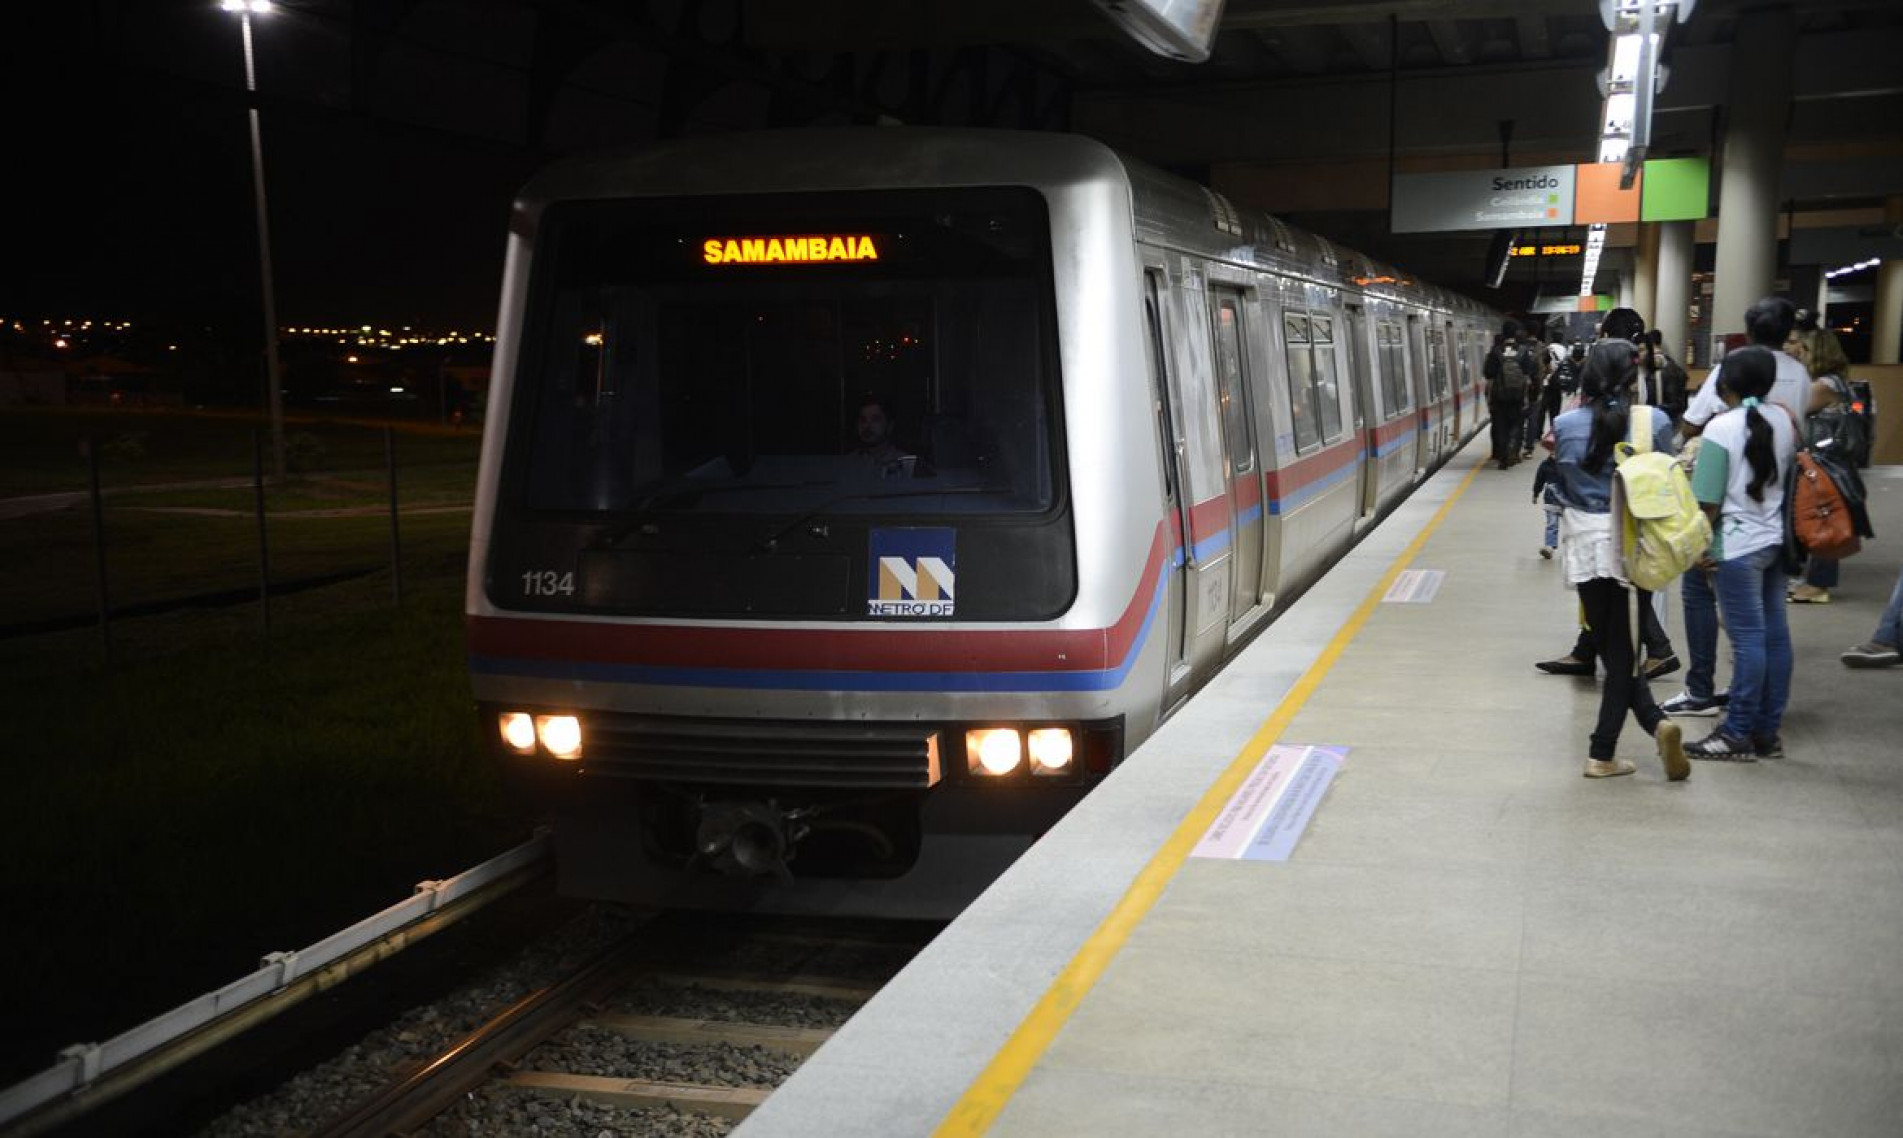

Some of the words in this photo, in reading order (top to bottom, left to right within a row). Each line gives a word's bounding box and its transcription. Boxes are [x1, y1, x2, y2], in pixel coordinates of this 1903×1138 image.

[1491, 174, 1559, 191] Sentido
[703, 235, 878, 264] SAMAMBAIA
[521, 570, 575, 598] 1134
[929, 603, 954, 616] DF
